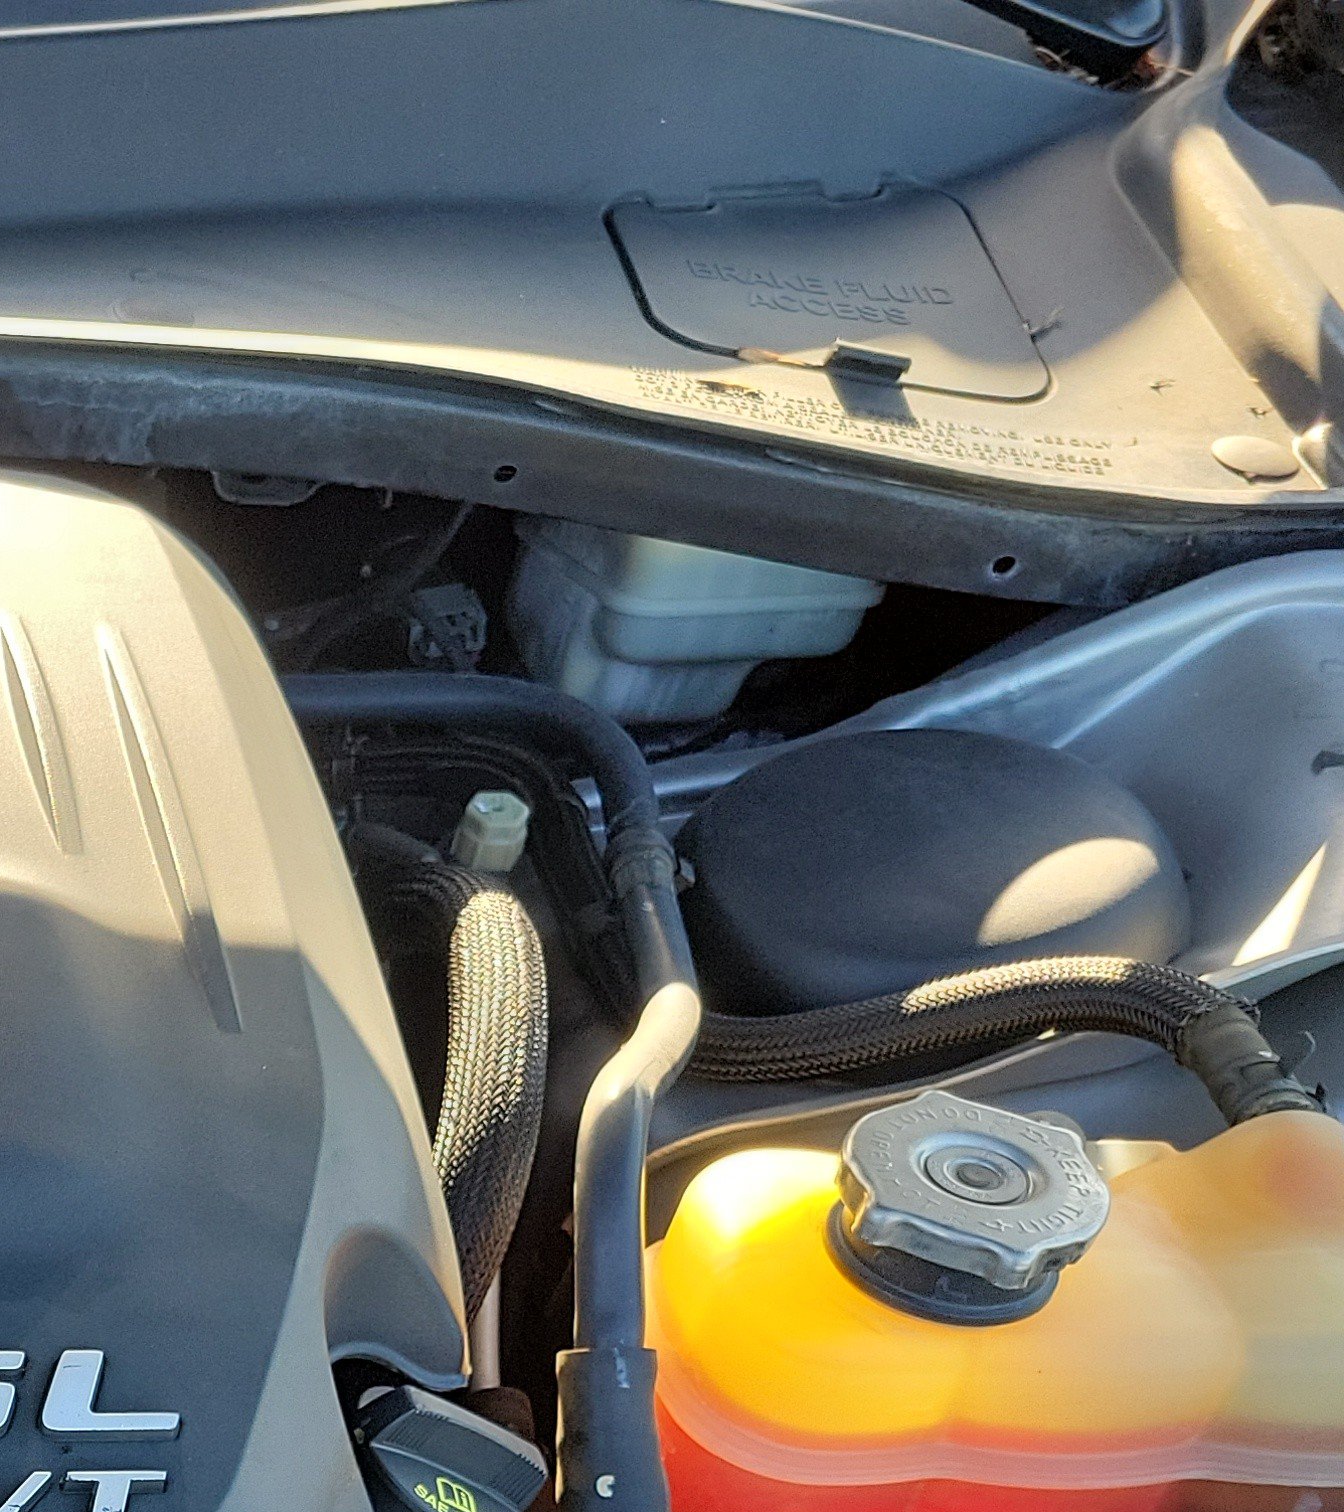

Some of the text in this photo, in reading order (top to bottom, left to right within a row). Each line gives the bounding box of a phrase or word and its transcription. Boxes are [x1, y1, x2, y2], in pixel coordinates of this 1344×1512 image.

[686, 258, 954, 305] BRAKE FLUID
[750, 293, 911, 325] ACCESS
